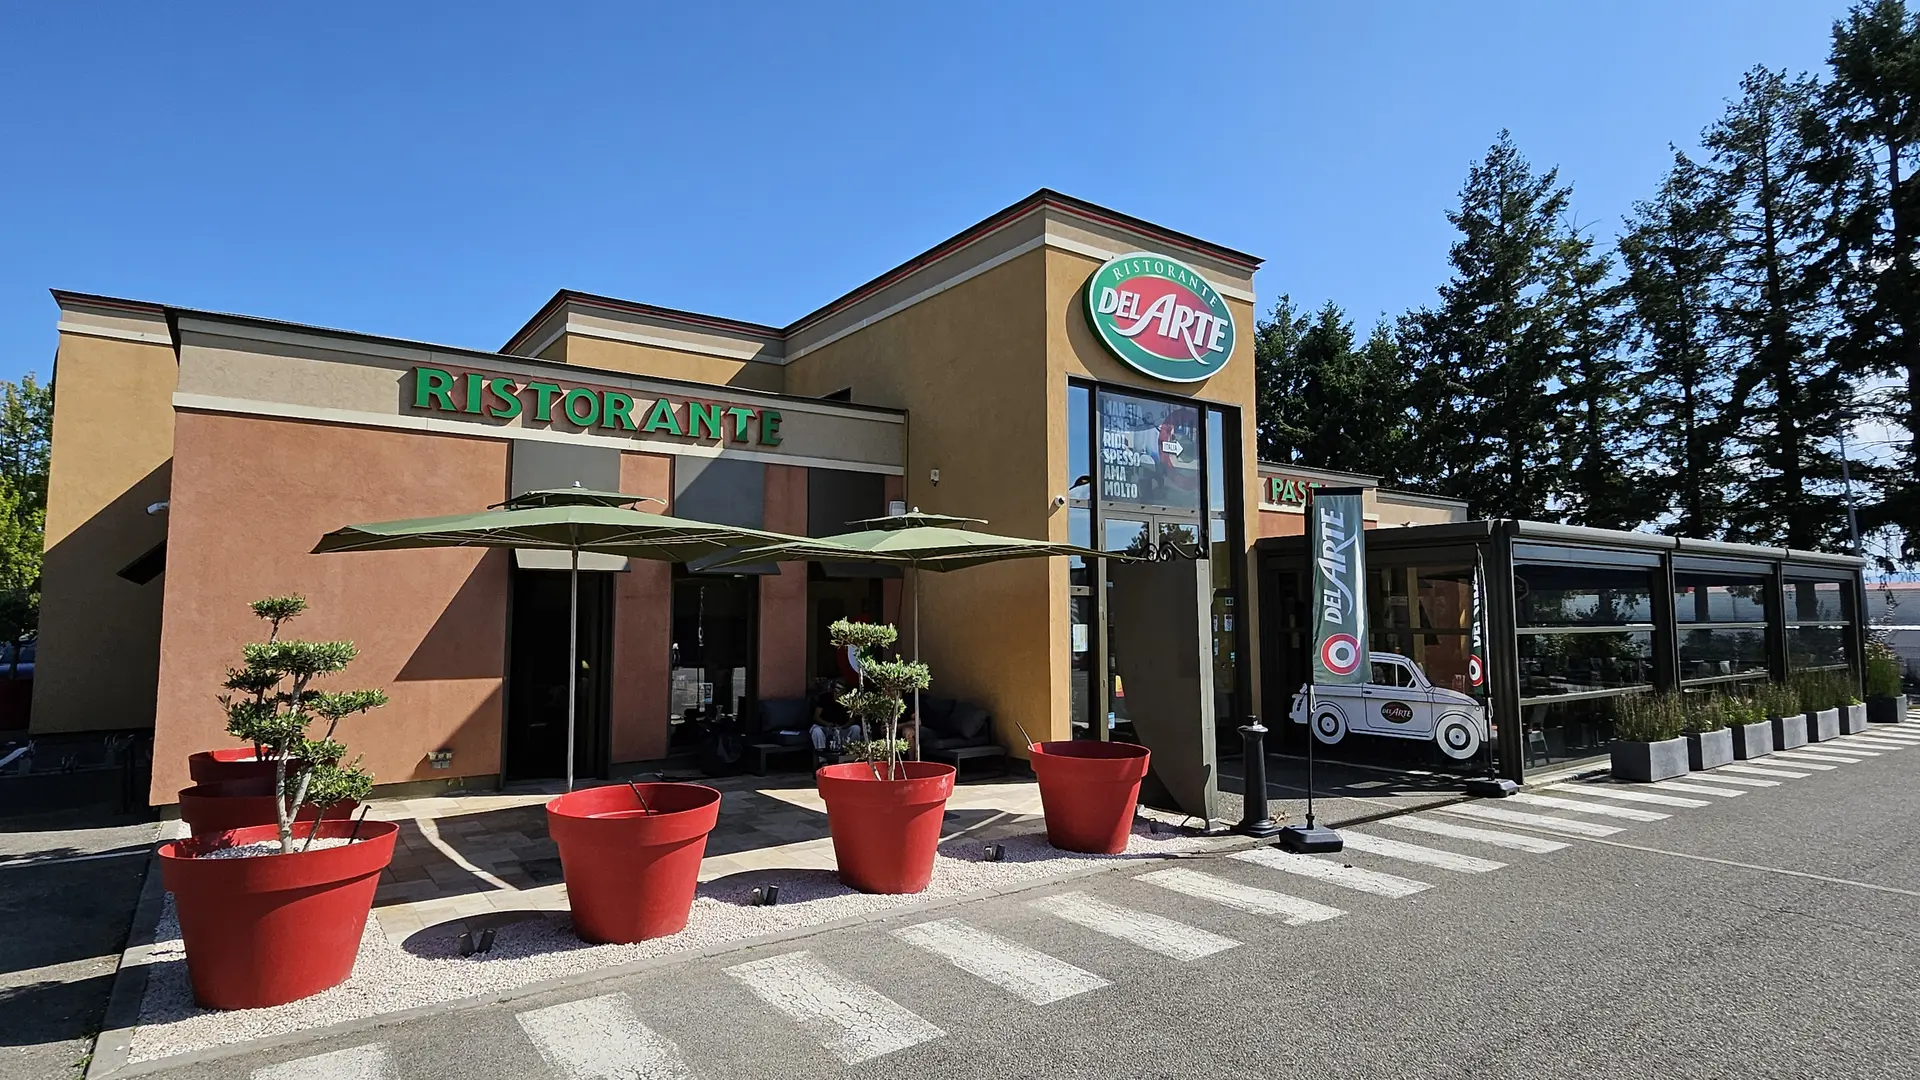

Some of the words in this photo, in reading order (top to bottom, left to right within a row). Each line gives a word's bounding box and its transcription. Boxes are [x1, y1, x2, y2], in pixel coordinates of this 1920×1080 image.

[1098, 286, 1141, 320] DEL
[1112, 260, 1218, 308] RISTORANTE
[1108, 294, 1229, 365] ARTE
[411, 366, 783, 447] RISTORANTE
[1104, 448, 1141, 467] SPESSO
[1104, 464, 1126, 481] AMA
[1105, 481, 1138, 499] MOLTO
[1318, 507, 1358, 617] ARTE
[1324, 588, 1343, 626] DEL
